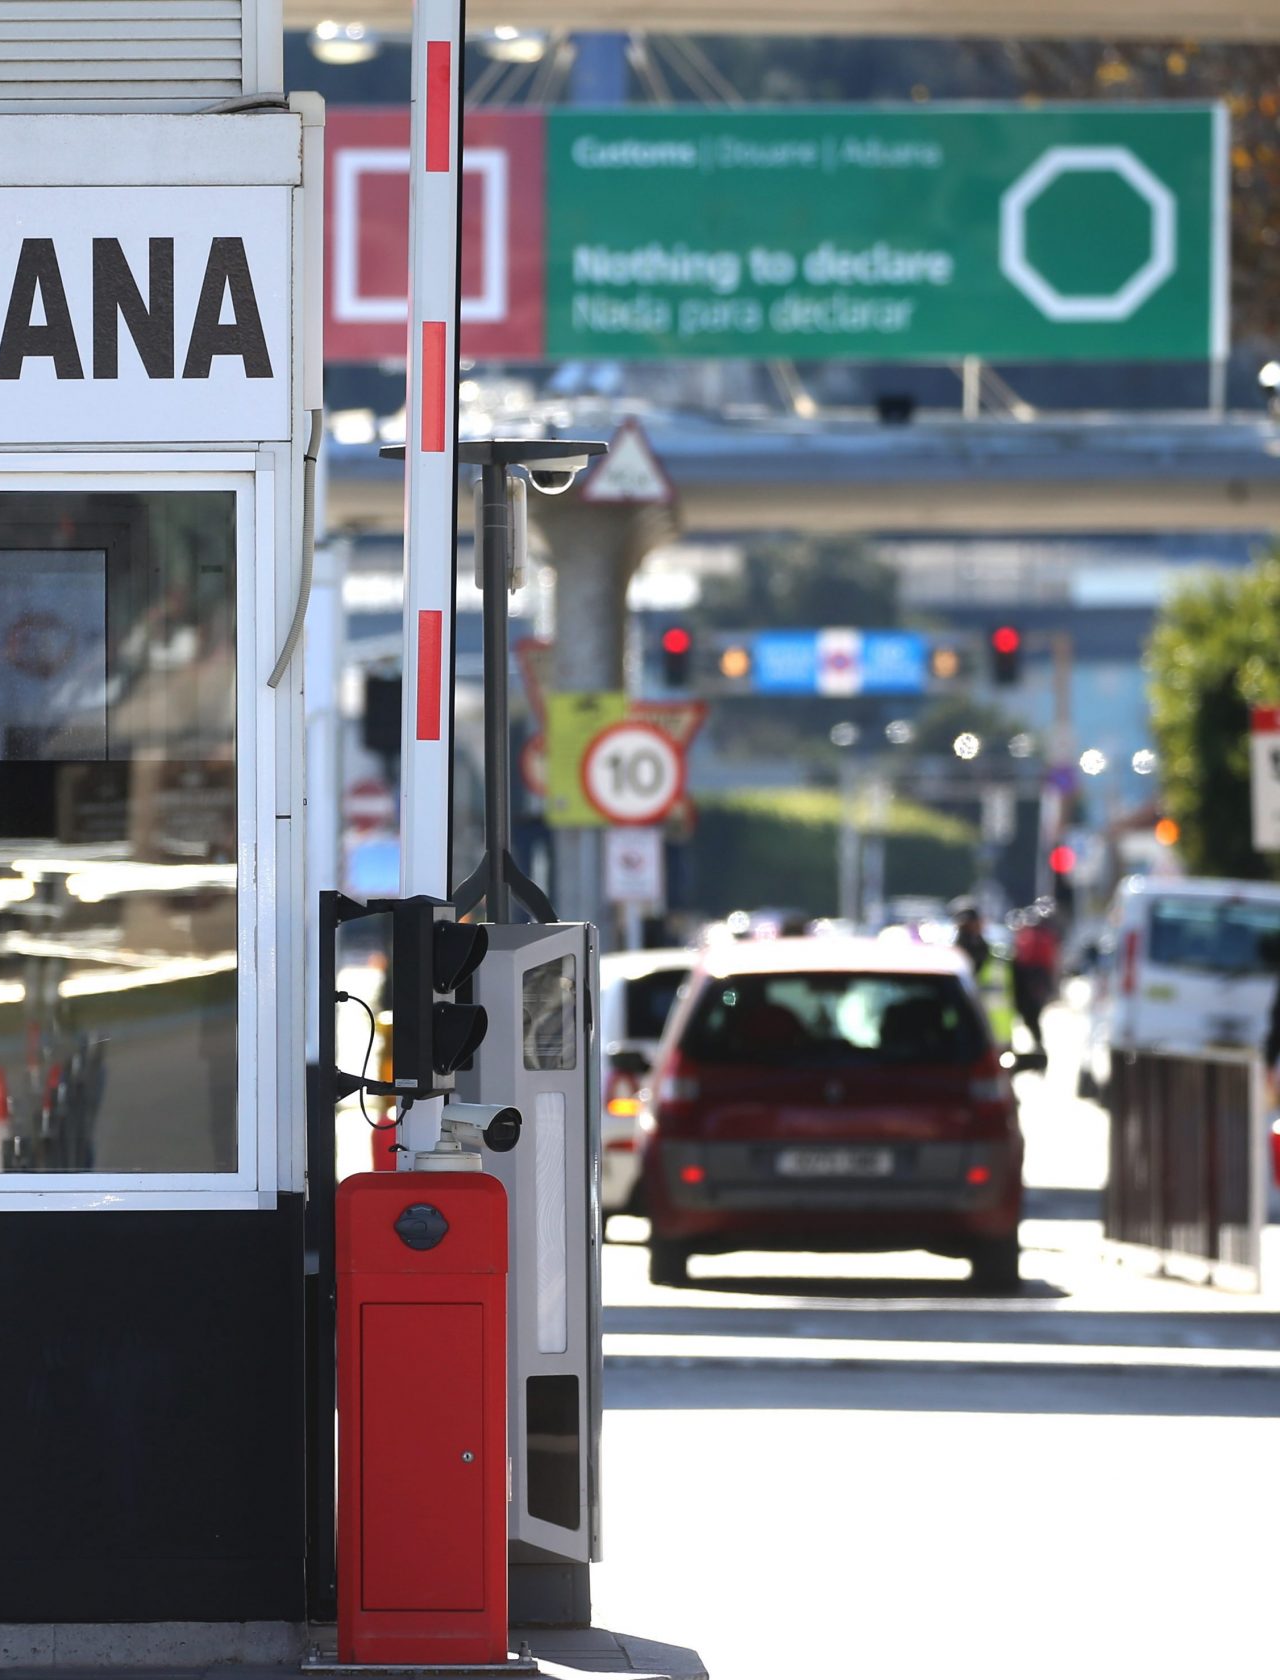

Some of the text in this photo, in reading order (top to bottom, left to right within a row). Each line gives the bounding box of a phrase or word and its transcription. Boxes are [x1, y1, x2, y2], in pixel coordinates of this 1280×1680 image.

[572, 136, 695, 168] Customs
[842, 136, 943, 168] Aduana
[573, 242, 953, 294] Nothing to declare
[573, 291, 914, 338] Nada para declarar
[605, 748, 665, 796] 10
